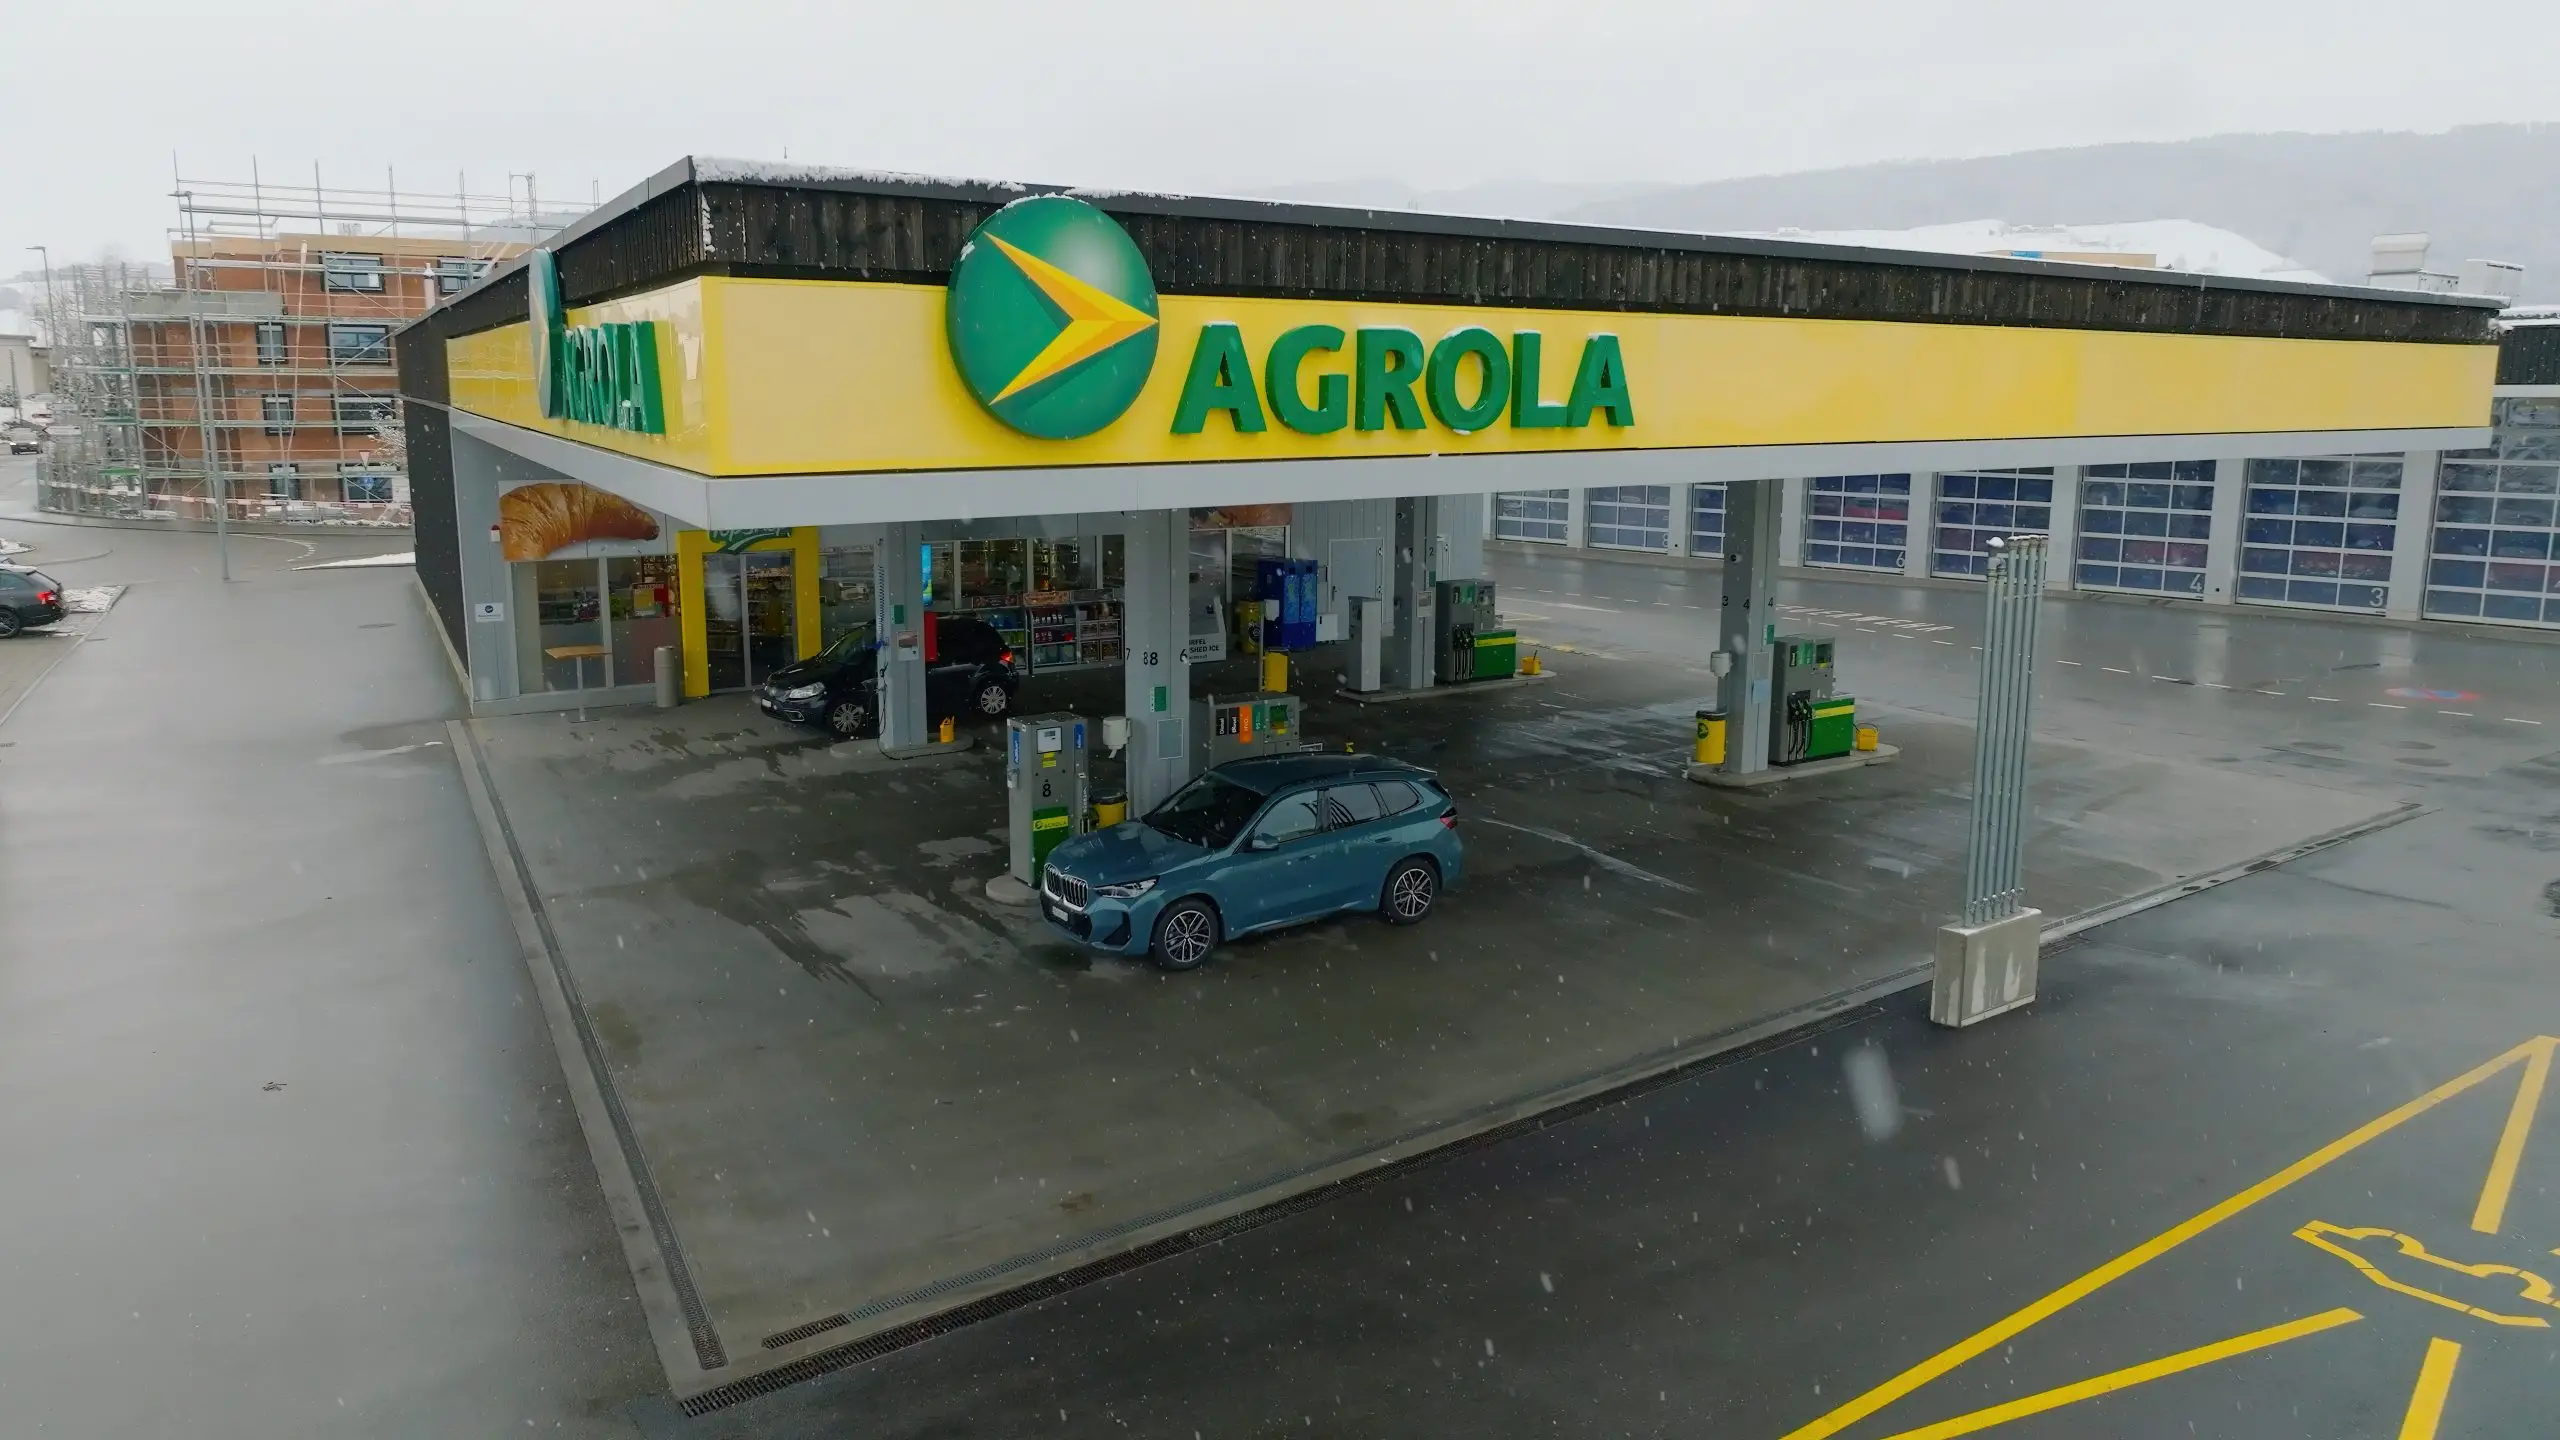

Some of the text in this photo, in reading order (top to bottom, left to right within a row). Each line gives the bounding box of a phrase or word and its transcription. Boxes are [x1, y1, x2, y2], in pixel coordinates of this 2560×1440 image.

[1170, 321, 1634, 435] AGROLA
[1895, 551, 1906, 568] 6
[2189, 573, 2203, 593] 4
[1743, 598, 1750, 610] 4
[1767, 597, 1774, 608] 4
[2369, 587, 2385, 608] 3
[1150, 651, 1159, 666] 8
[1042, 783, 1052, 798] 8
